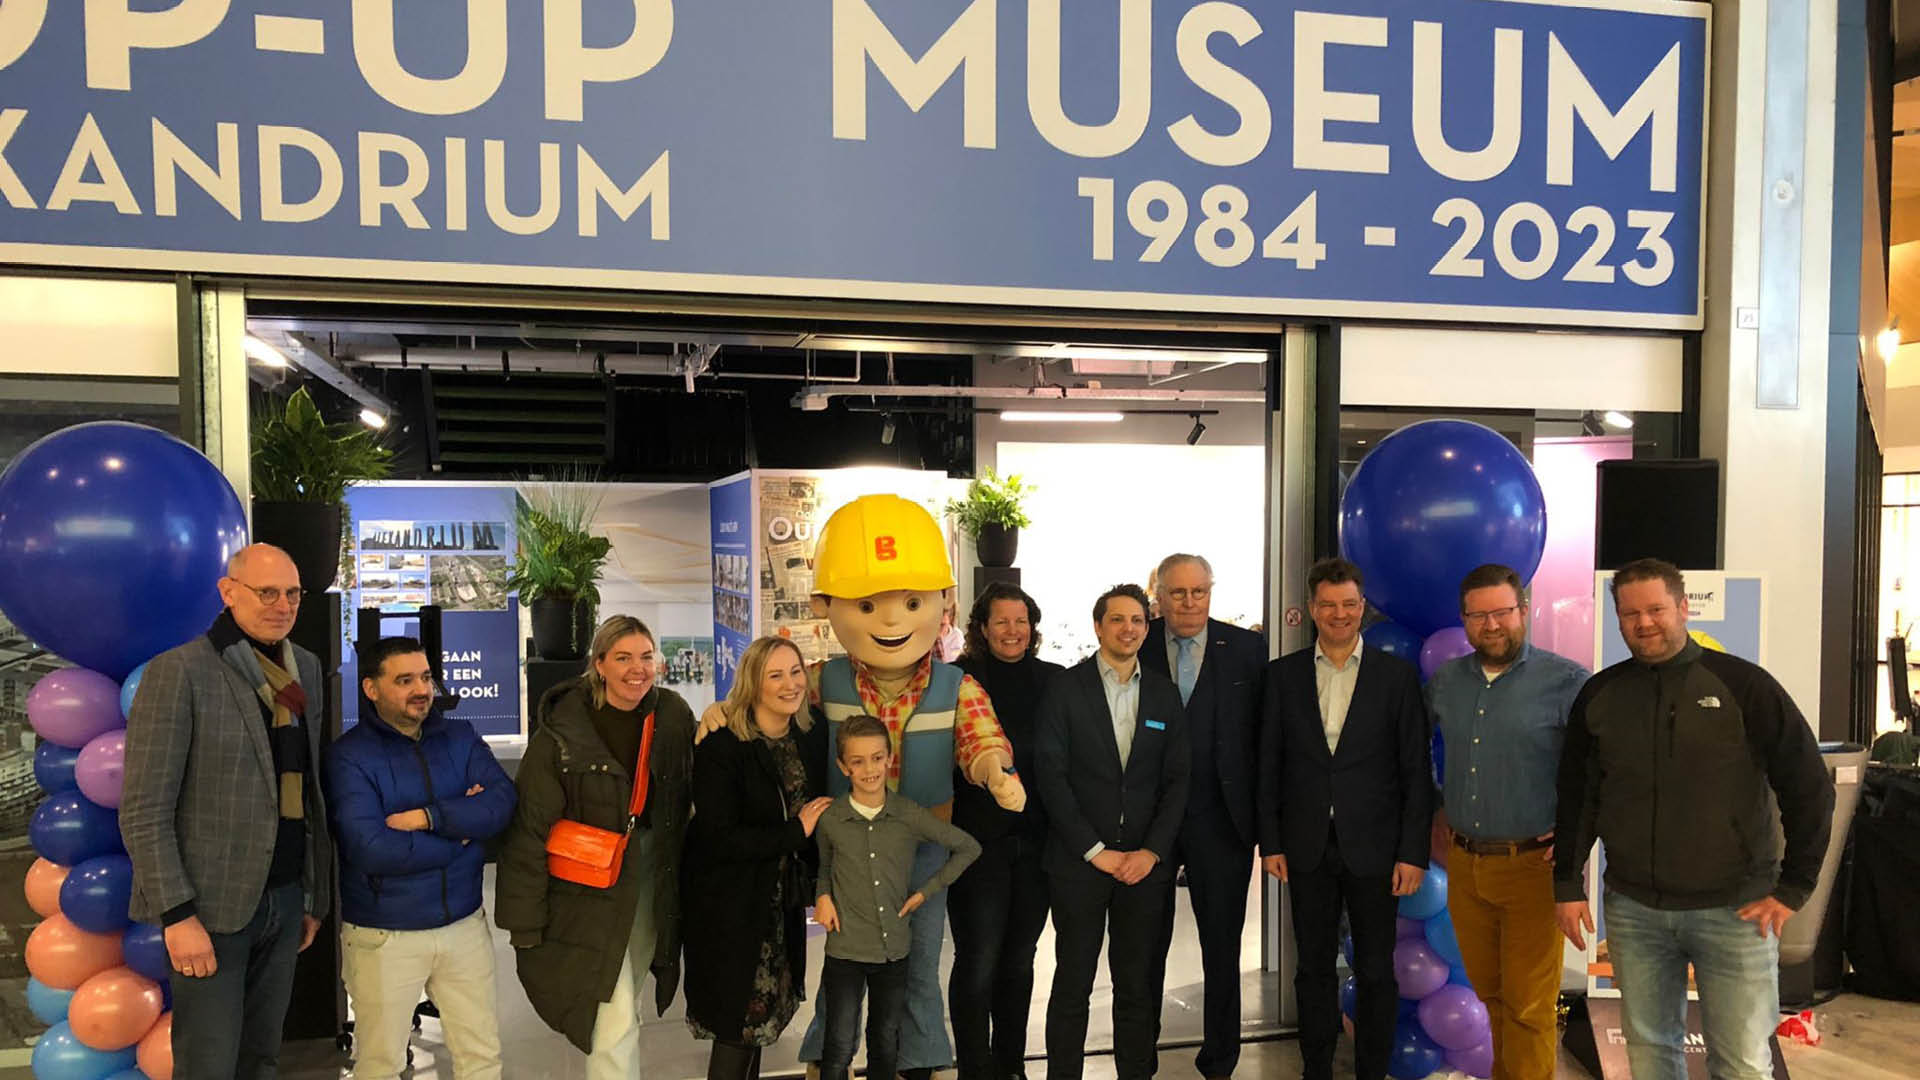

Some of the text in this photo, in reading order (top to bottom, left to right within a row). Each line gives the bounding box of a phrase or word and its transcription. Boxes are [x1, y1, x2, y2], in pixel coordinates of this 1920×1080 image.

[0, 0, 1680, 193] P-UP MUSEUM
[1078, 177, 1326, 270] 1984
[1429, 198, 1675, 286] 2023
[875, 536, 897, 561] B
[453, 668, 482, 680] EEN
